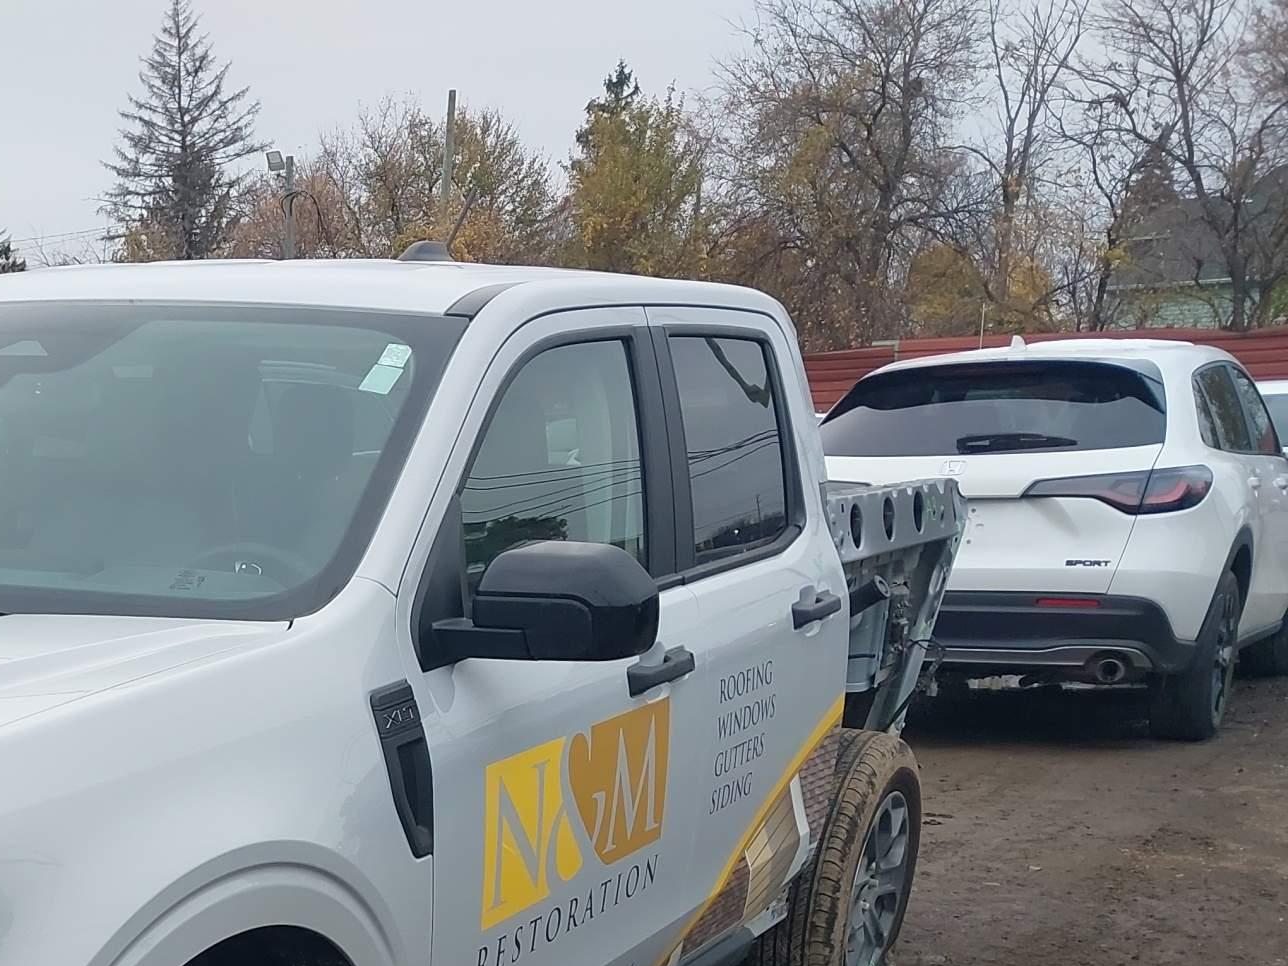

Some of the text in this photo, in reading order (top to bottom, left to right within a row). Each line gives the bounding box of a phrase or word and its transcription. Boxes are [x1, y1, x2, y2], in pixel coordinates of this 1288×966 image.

[1065, 559, 1112, 567] SPORT
[719, 660, 773, 704] ROOFING
[384, 706, 415, 729] XLT
[717, 693, 777, 740] WINDOWS
[714, 732, 766, 777] GUTTERS
[709, 772, 753, 815] SIDING
